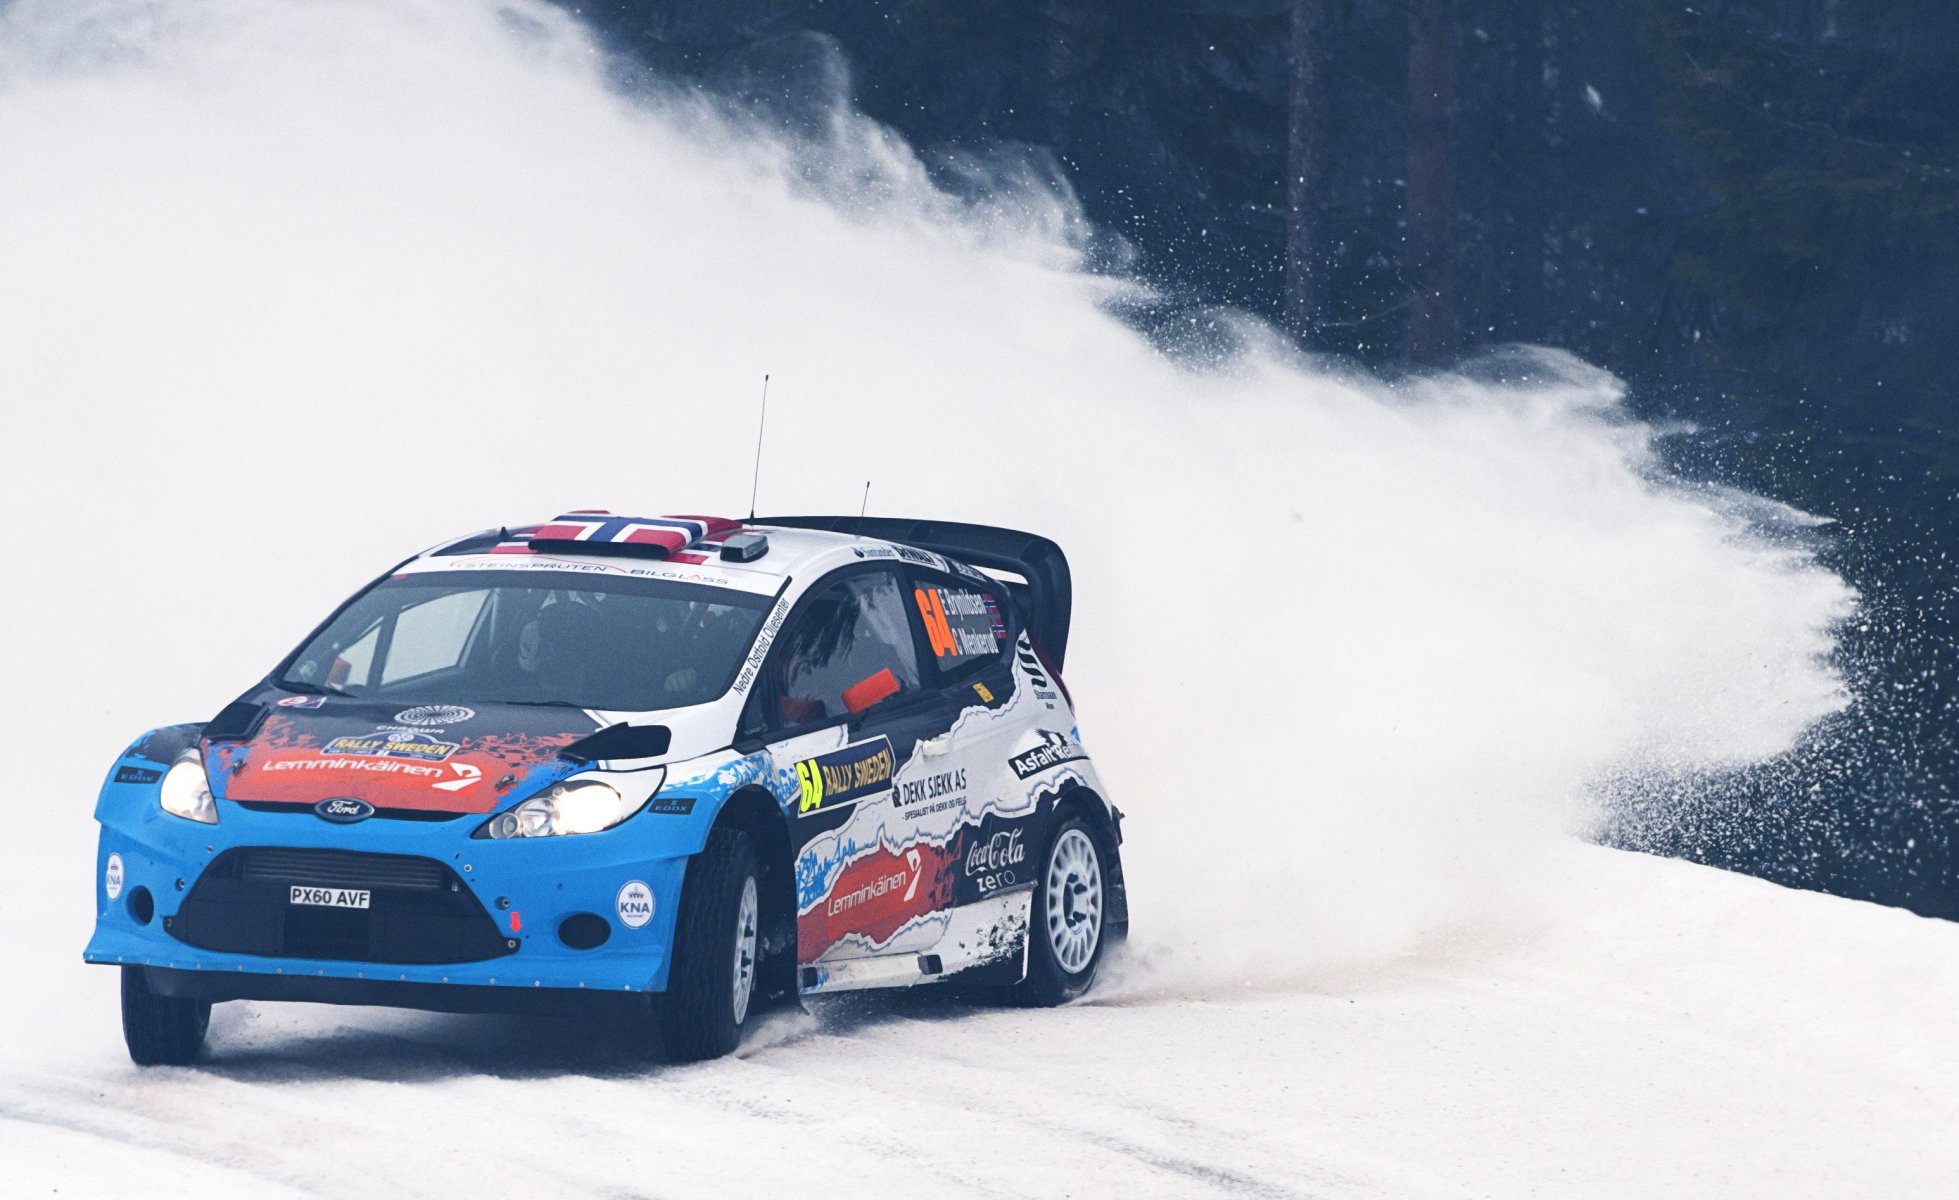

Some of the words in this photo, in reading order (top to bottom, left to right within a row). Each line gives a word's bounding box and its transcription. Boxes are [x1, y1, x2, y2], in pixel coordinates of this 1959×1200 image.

[464, 562, 607, 572] STEINSPRUTEN
[629, 568, 728, 585] BILGLASS
[937, 588, 950, 616] E
[944, 588, 988, 622] Brynildsen
[915, 588, 958, 657] 64
[952, 627, 963, 656] C
[732, 667, 754, 696] Nedre
[333, 738, 383, 749] RALLY
[382, 741, 451, 755] SWEDEN
[262, 757, 444, 778] Lemminkäinen
[822, 764, 852, 797] RALLY
[854, 747, 892, 789] SWEDEN
[795, 758, 824, 813] 64
[902, 778, 927, 806] DEKK
[927, 771, 954, 799] SJEKK
[955, 767, 967, 792] AS
[327, 799, 360, 815] Ford
[904, 806, 929, 821] SPESIALIST
[936, 801, 949, 813] DEKK
[948, 799, 956, 809] OG
[827, 870, 907, 917] Lemminkäinen
[976, 870, 1016, 893] zero
[292, 888, 332, 904] PX60
[336, 891, 369, 906] AVF
[620, 902, 650, 913] KNA
